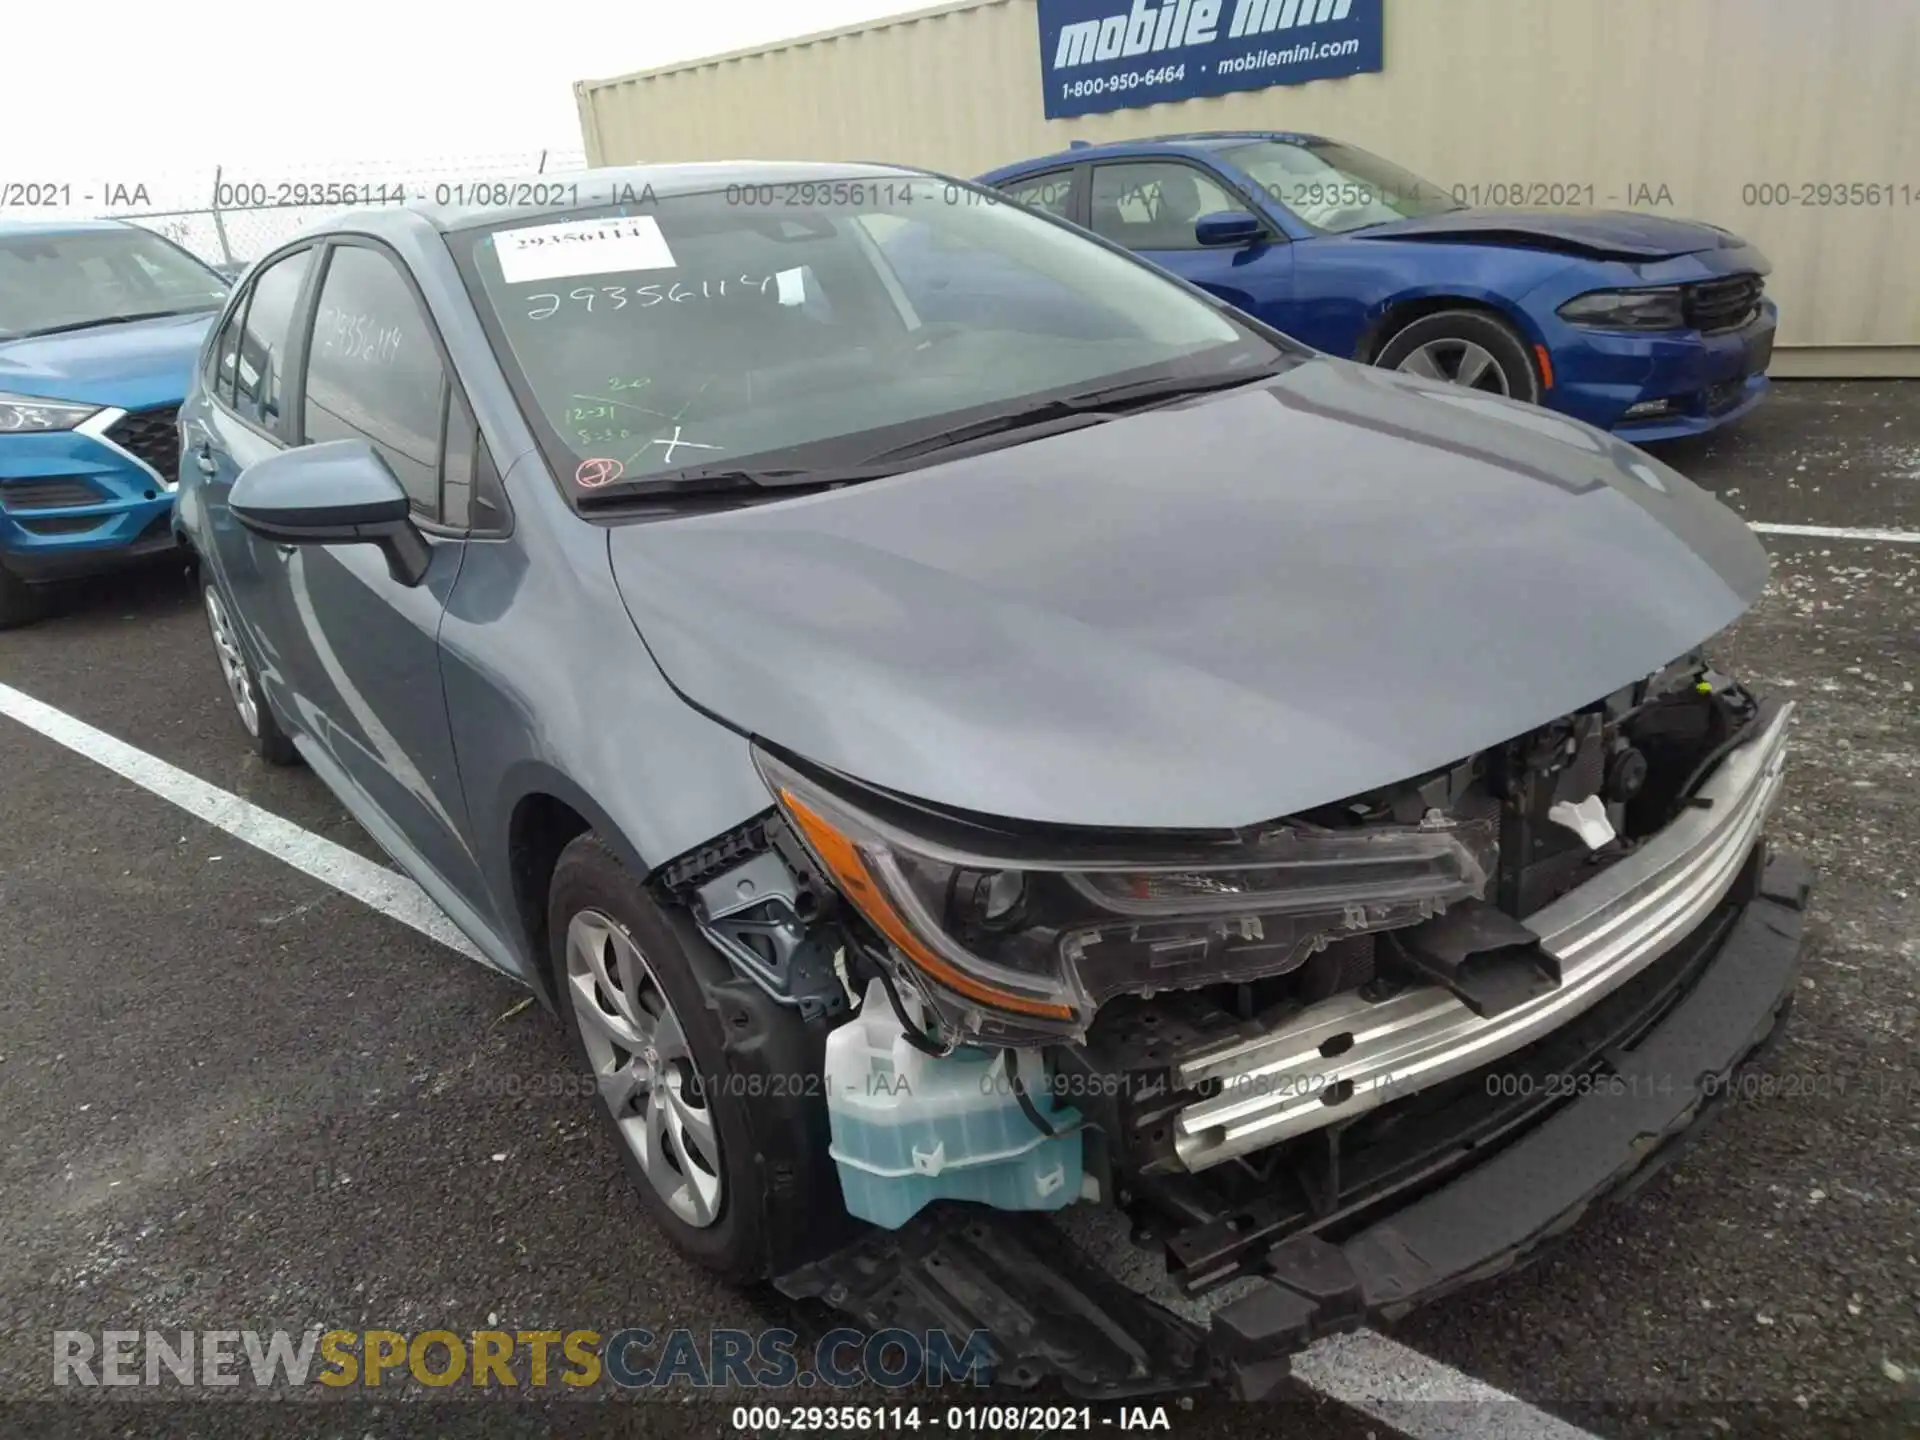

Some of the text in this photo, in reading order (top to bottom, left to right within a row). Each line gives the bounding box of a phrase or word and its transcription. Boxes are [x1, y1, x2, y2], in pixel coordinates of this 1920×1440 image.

[1054, 0, 1222, 69] mobile
[1062, 38, 1360, 100] 1-800-950-6464 mobilemini.com
